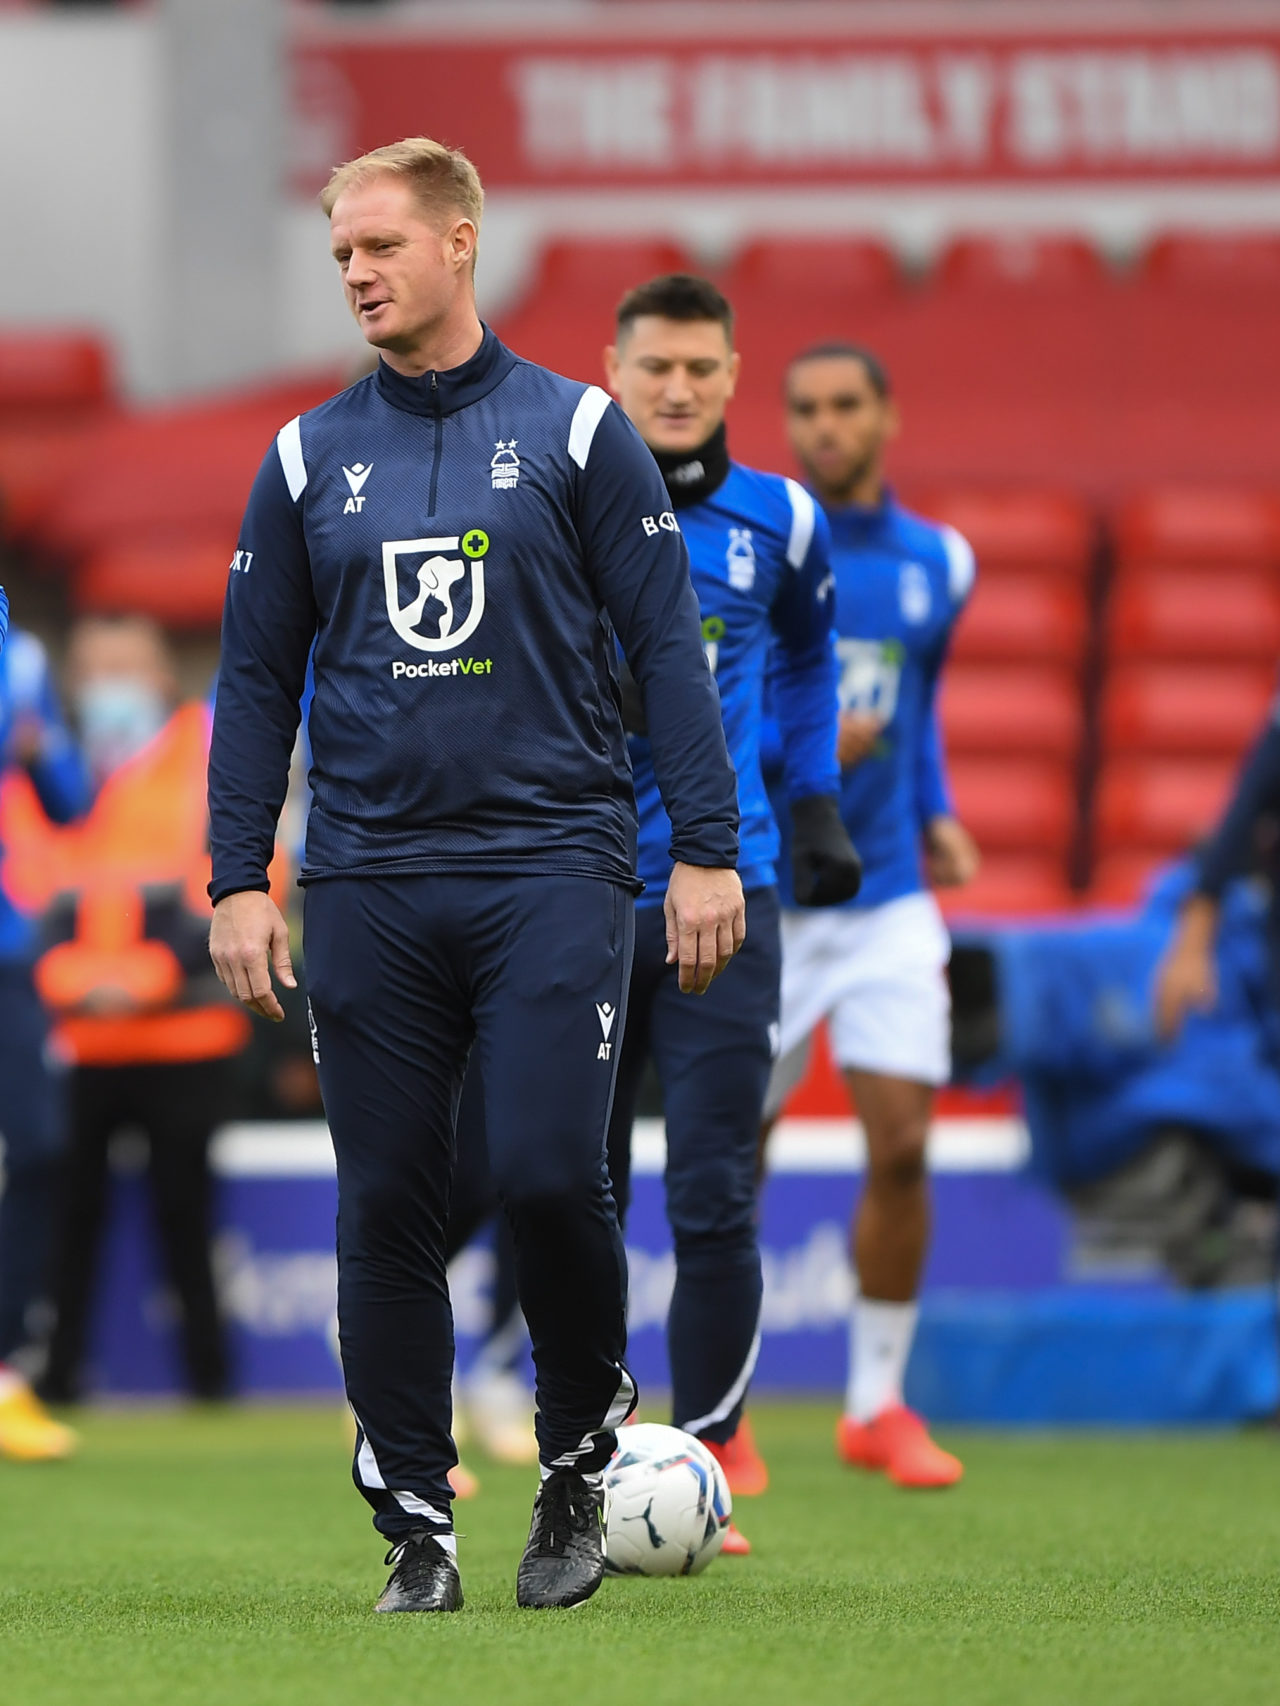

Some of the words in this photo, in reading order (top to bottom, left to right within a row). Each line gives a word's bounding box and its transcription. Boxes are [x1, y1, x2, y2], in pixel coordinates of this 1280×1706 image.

[516, 57, 672, 165] THE
[693, 52, 996, 164] FAMILY
[343, 496, 366, 514] AT
[229, 550, 254, 573] XT
[392, 657, 493, 680] PocketVet
[597, 1042, 612, 1060] AT
